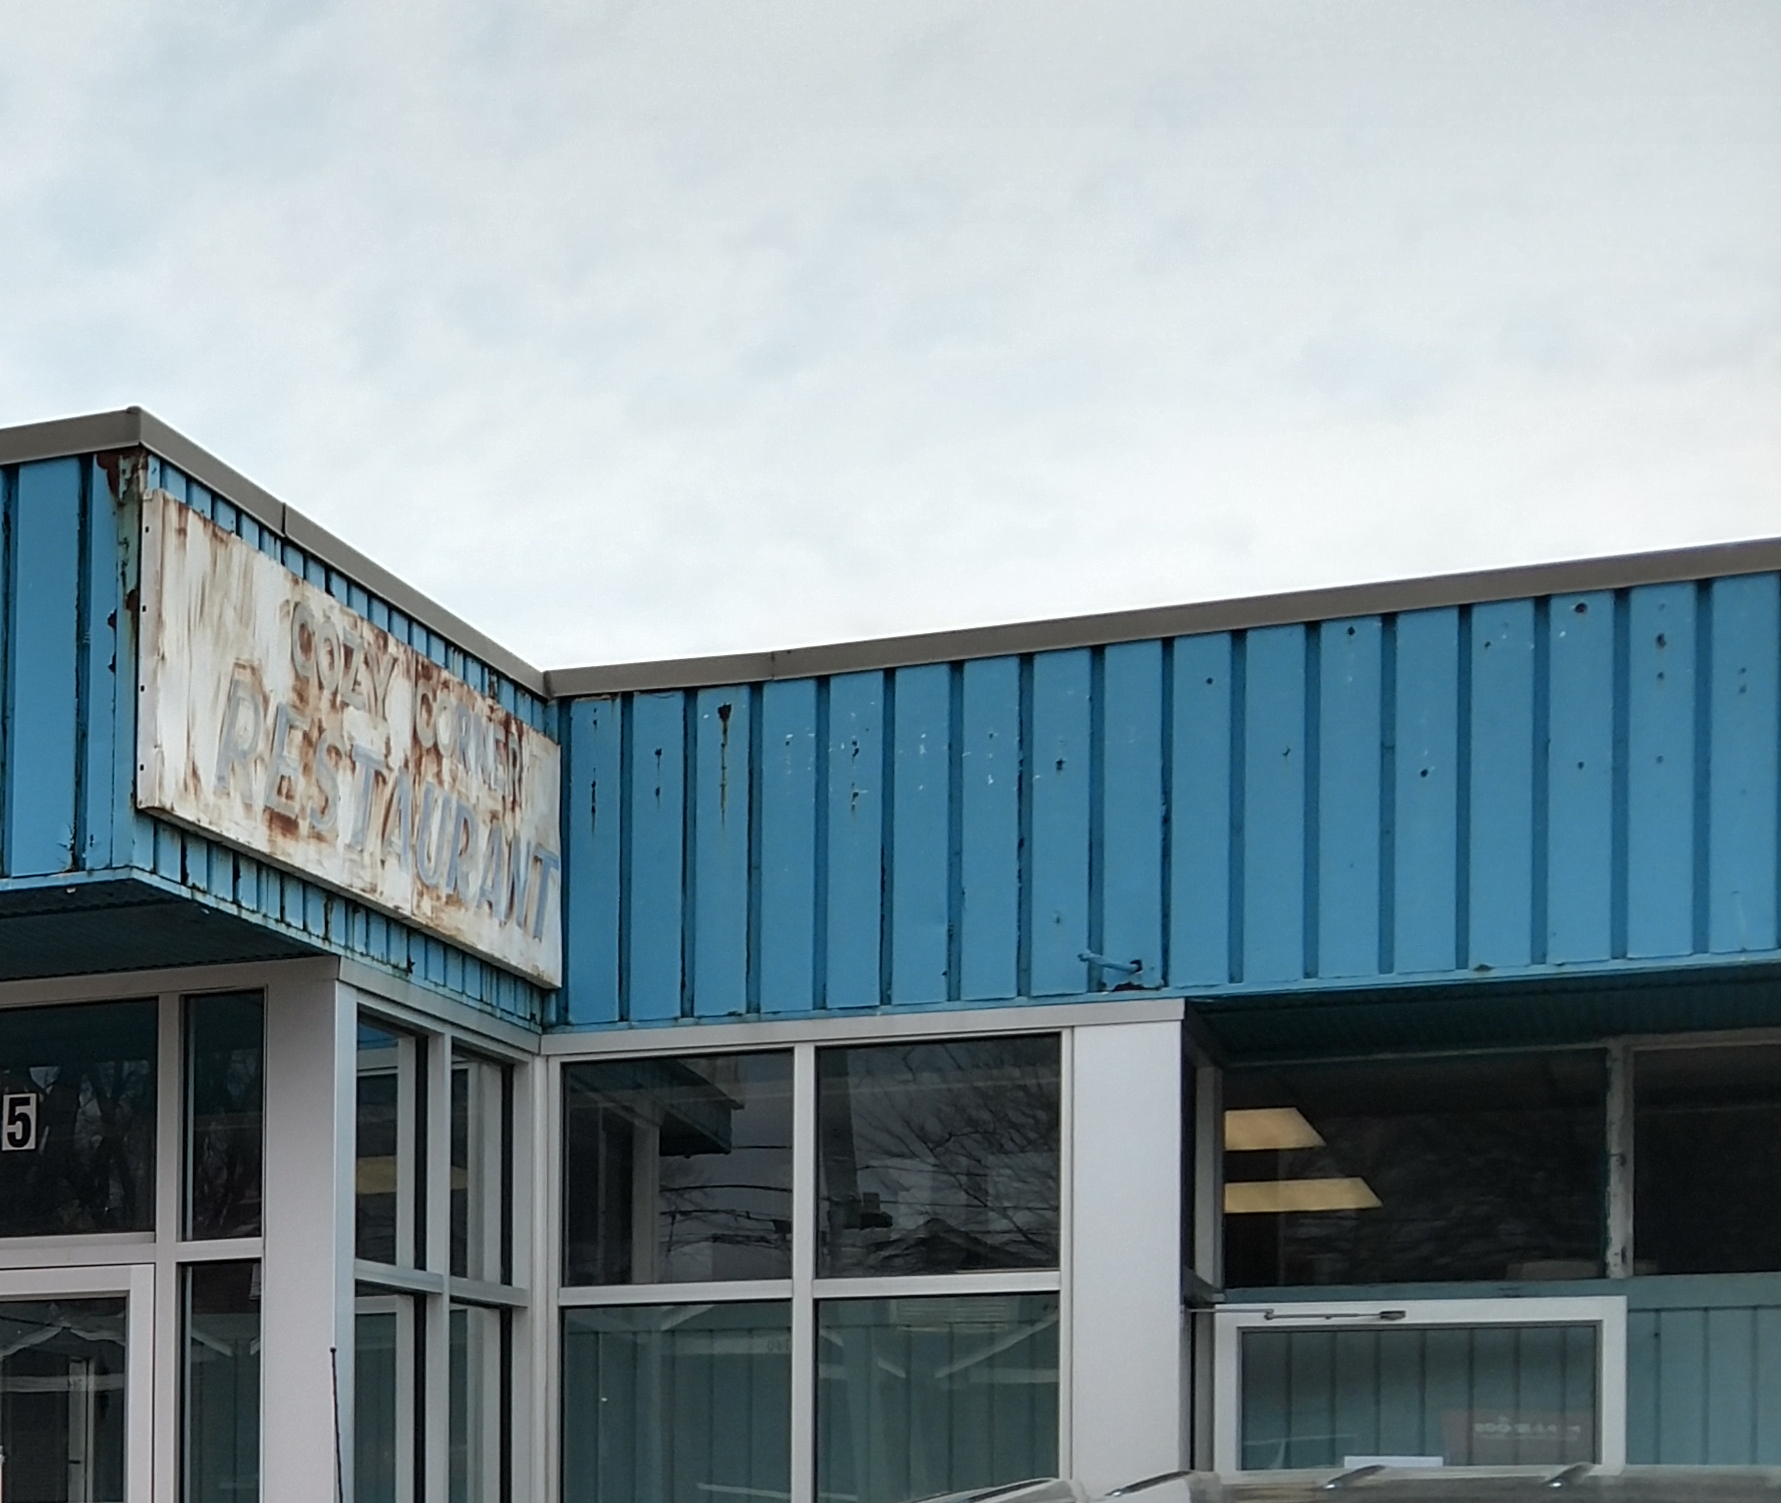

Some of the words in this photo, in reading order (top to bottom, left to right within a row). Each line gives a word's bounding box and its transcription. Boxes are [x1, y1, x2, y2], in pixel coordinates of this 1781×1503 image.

[213, 672, 559, 942] RESTAURANT
[290, 602, 399, 722] COZY
[414, 679, 523, 808] CORNER
